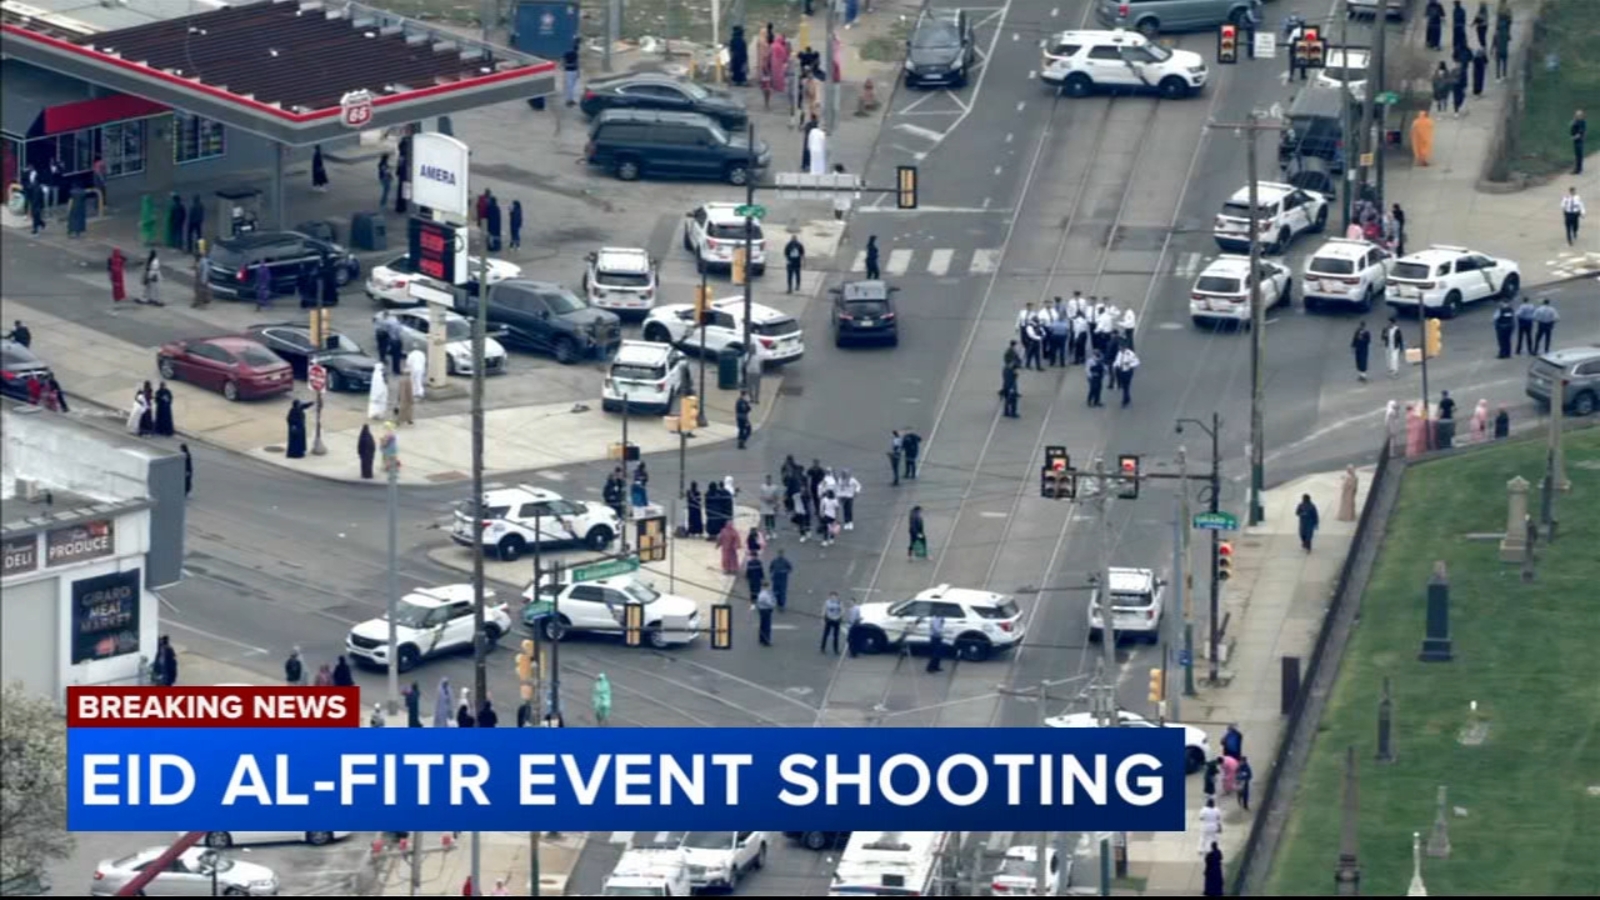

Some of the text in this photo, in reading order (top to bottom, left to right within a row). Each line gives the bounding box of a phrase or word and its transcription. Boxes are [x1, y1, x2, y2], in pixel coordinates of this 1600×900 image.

[350, 106, 367, 122] 66
[420, 164, 456, 186] AMERA
[49, 536, 108, 559] PRODUCE
[5, 552, 32, 569] DELI
